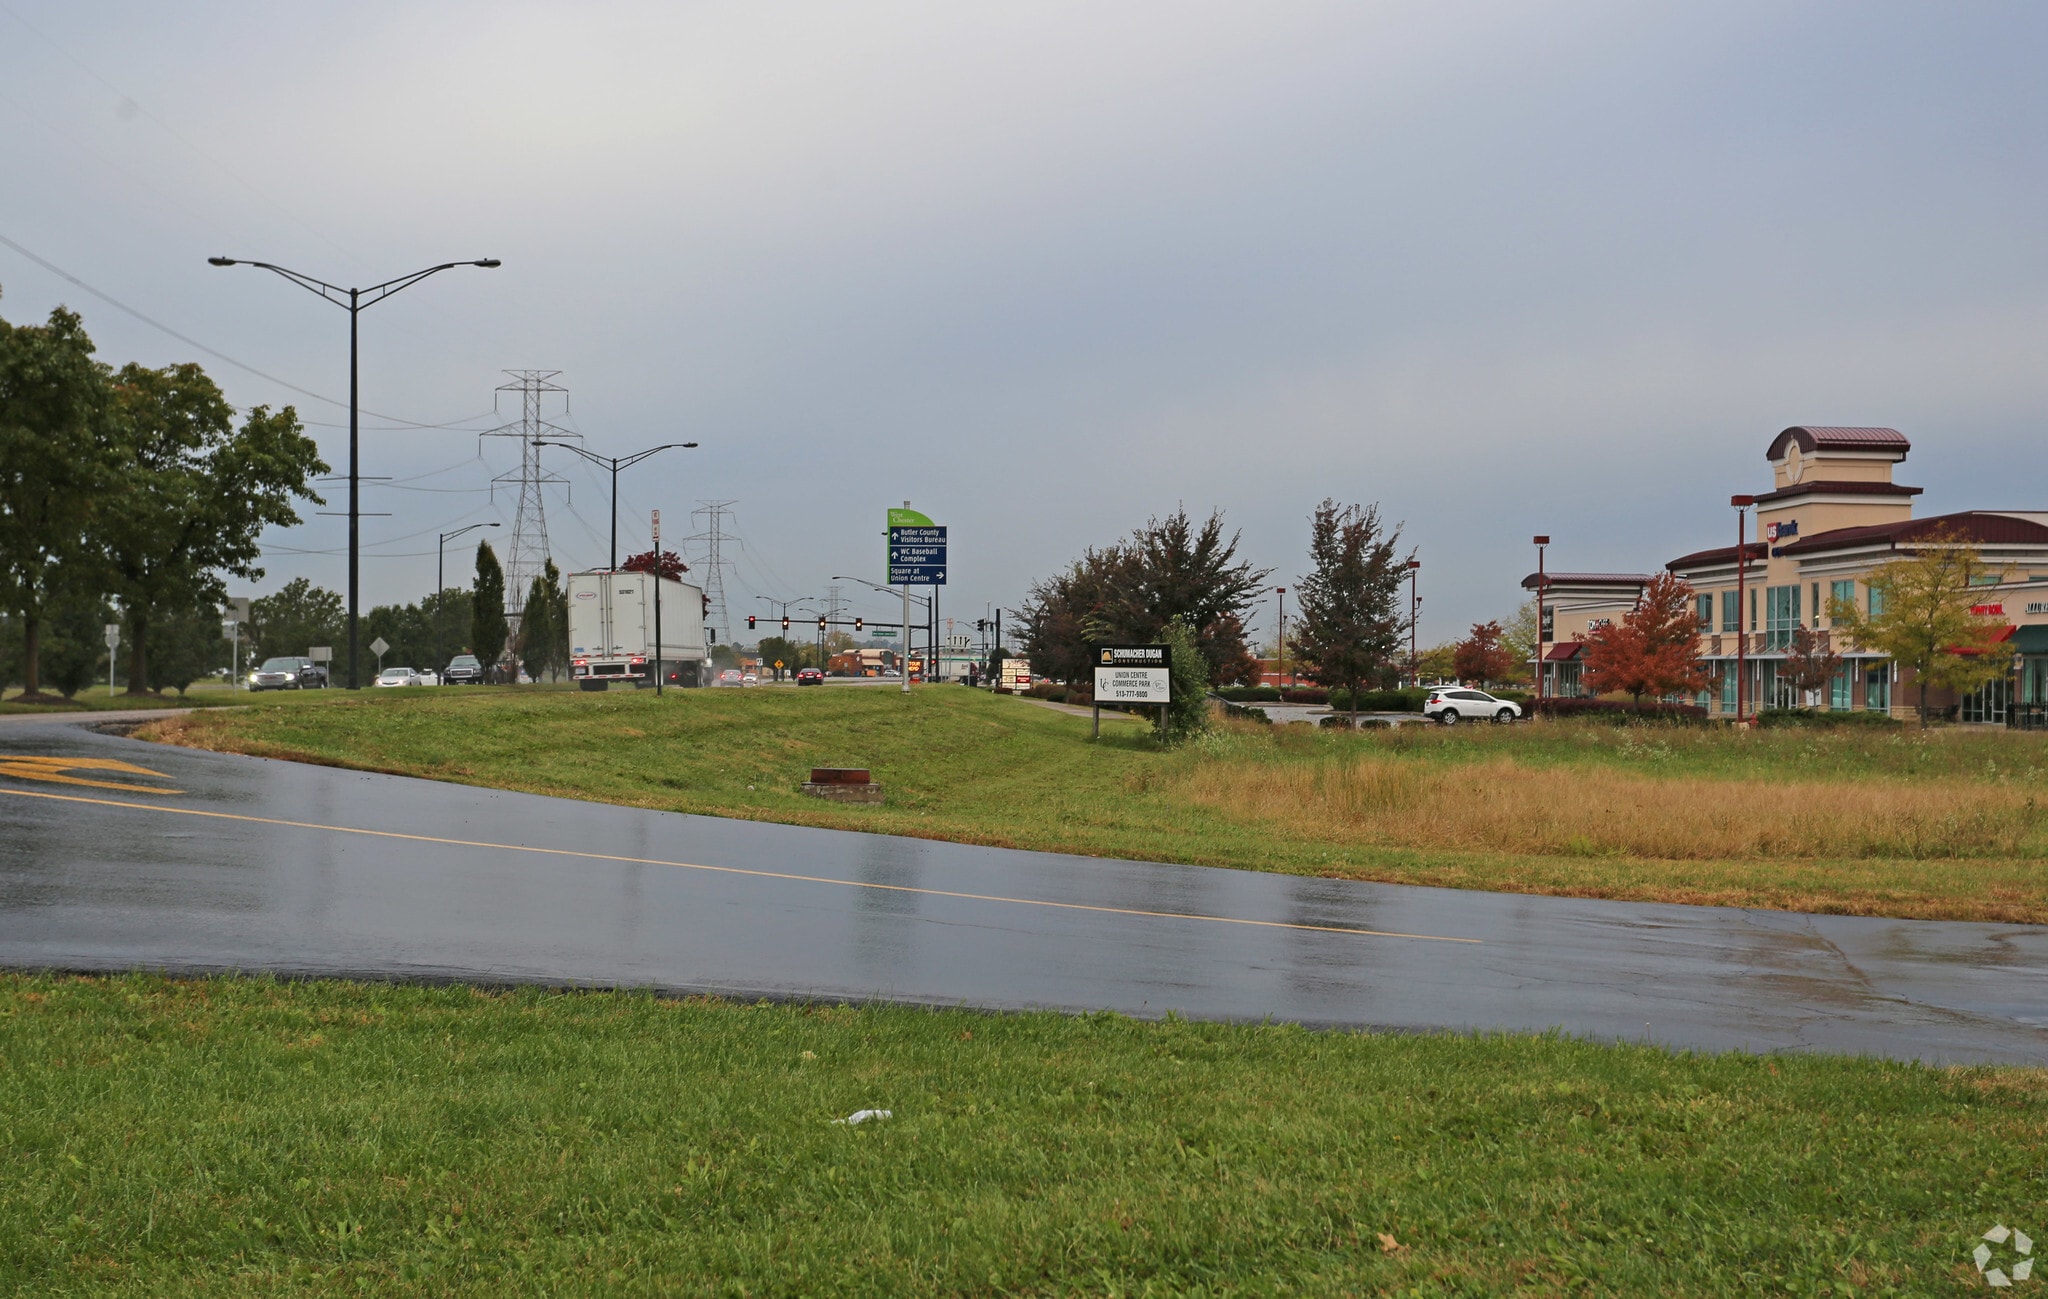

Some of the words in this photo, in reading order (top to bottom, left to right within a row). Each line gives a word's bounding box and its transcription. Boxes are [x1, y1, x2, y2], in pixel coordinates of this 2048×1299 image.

[919, 529, 940, 537] County
[900, 555, 926, 563] Complex
[890, 567, 912, 575] Square
[909, 574, 930, 582] Centre
[1114, 648, 1145, 658] SCHUMACHER
[1146, 648, 1162, 658] DUGAN
